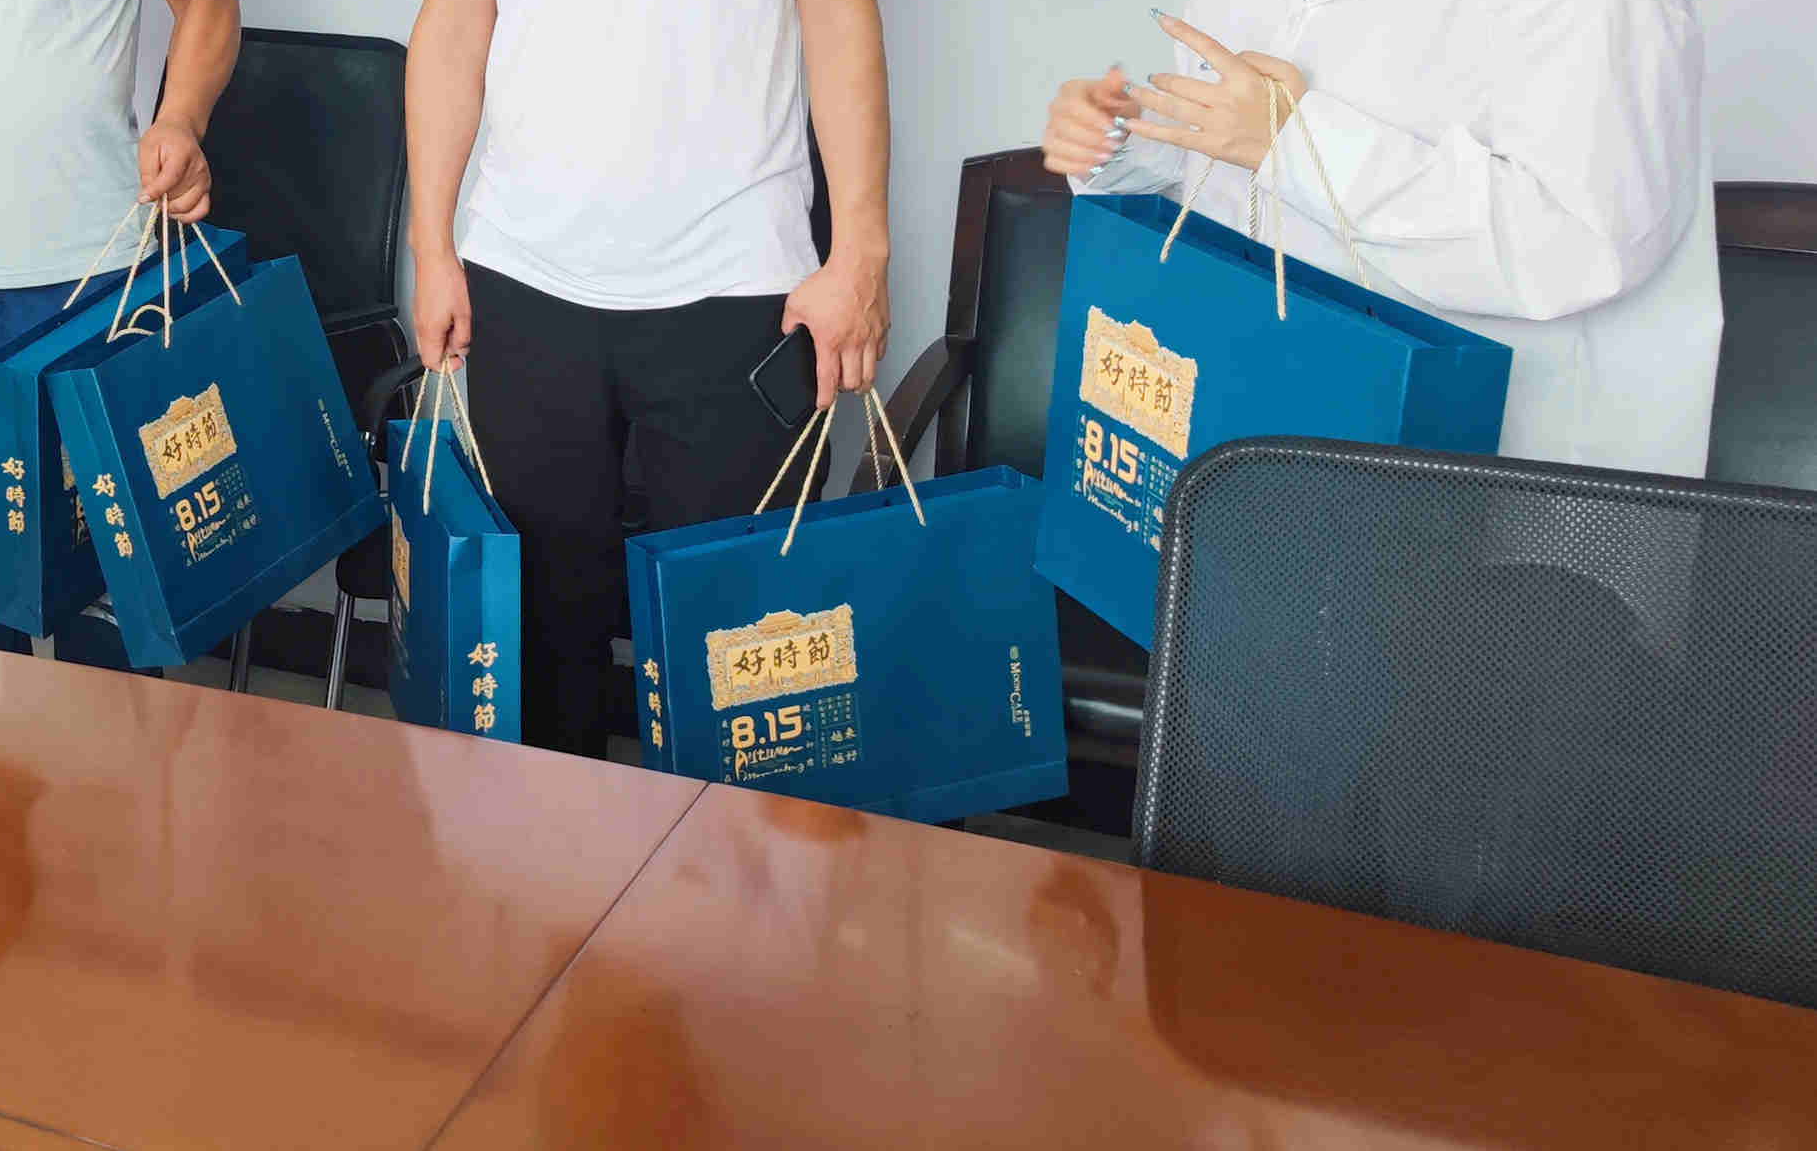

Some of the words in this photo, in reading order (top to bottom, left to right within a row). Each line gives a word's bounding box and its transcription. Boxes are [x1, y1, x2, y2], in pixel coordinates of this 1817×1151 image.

[1100, 349, 1174, 413] 好時節
[161, 411, 218, 465] 好時節
[1084, 420, 1140, 484] 8.15
[1, 456, 26, 535] 好時節
[92, 473, 134, 559] 好時節
[176, 481, 221, 531] 8.15
[467, 642, 498, 733] 好時節
[733, 633, 831, 678] 好時節
[731, 705, 802, 749] 8.15
